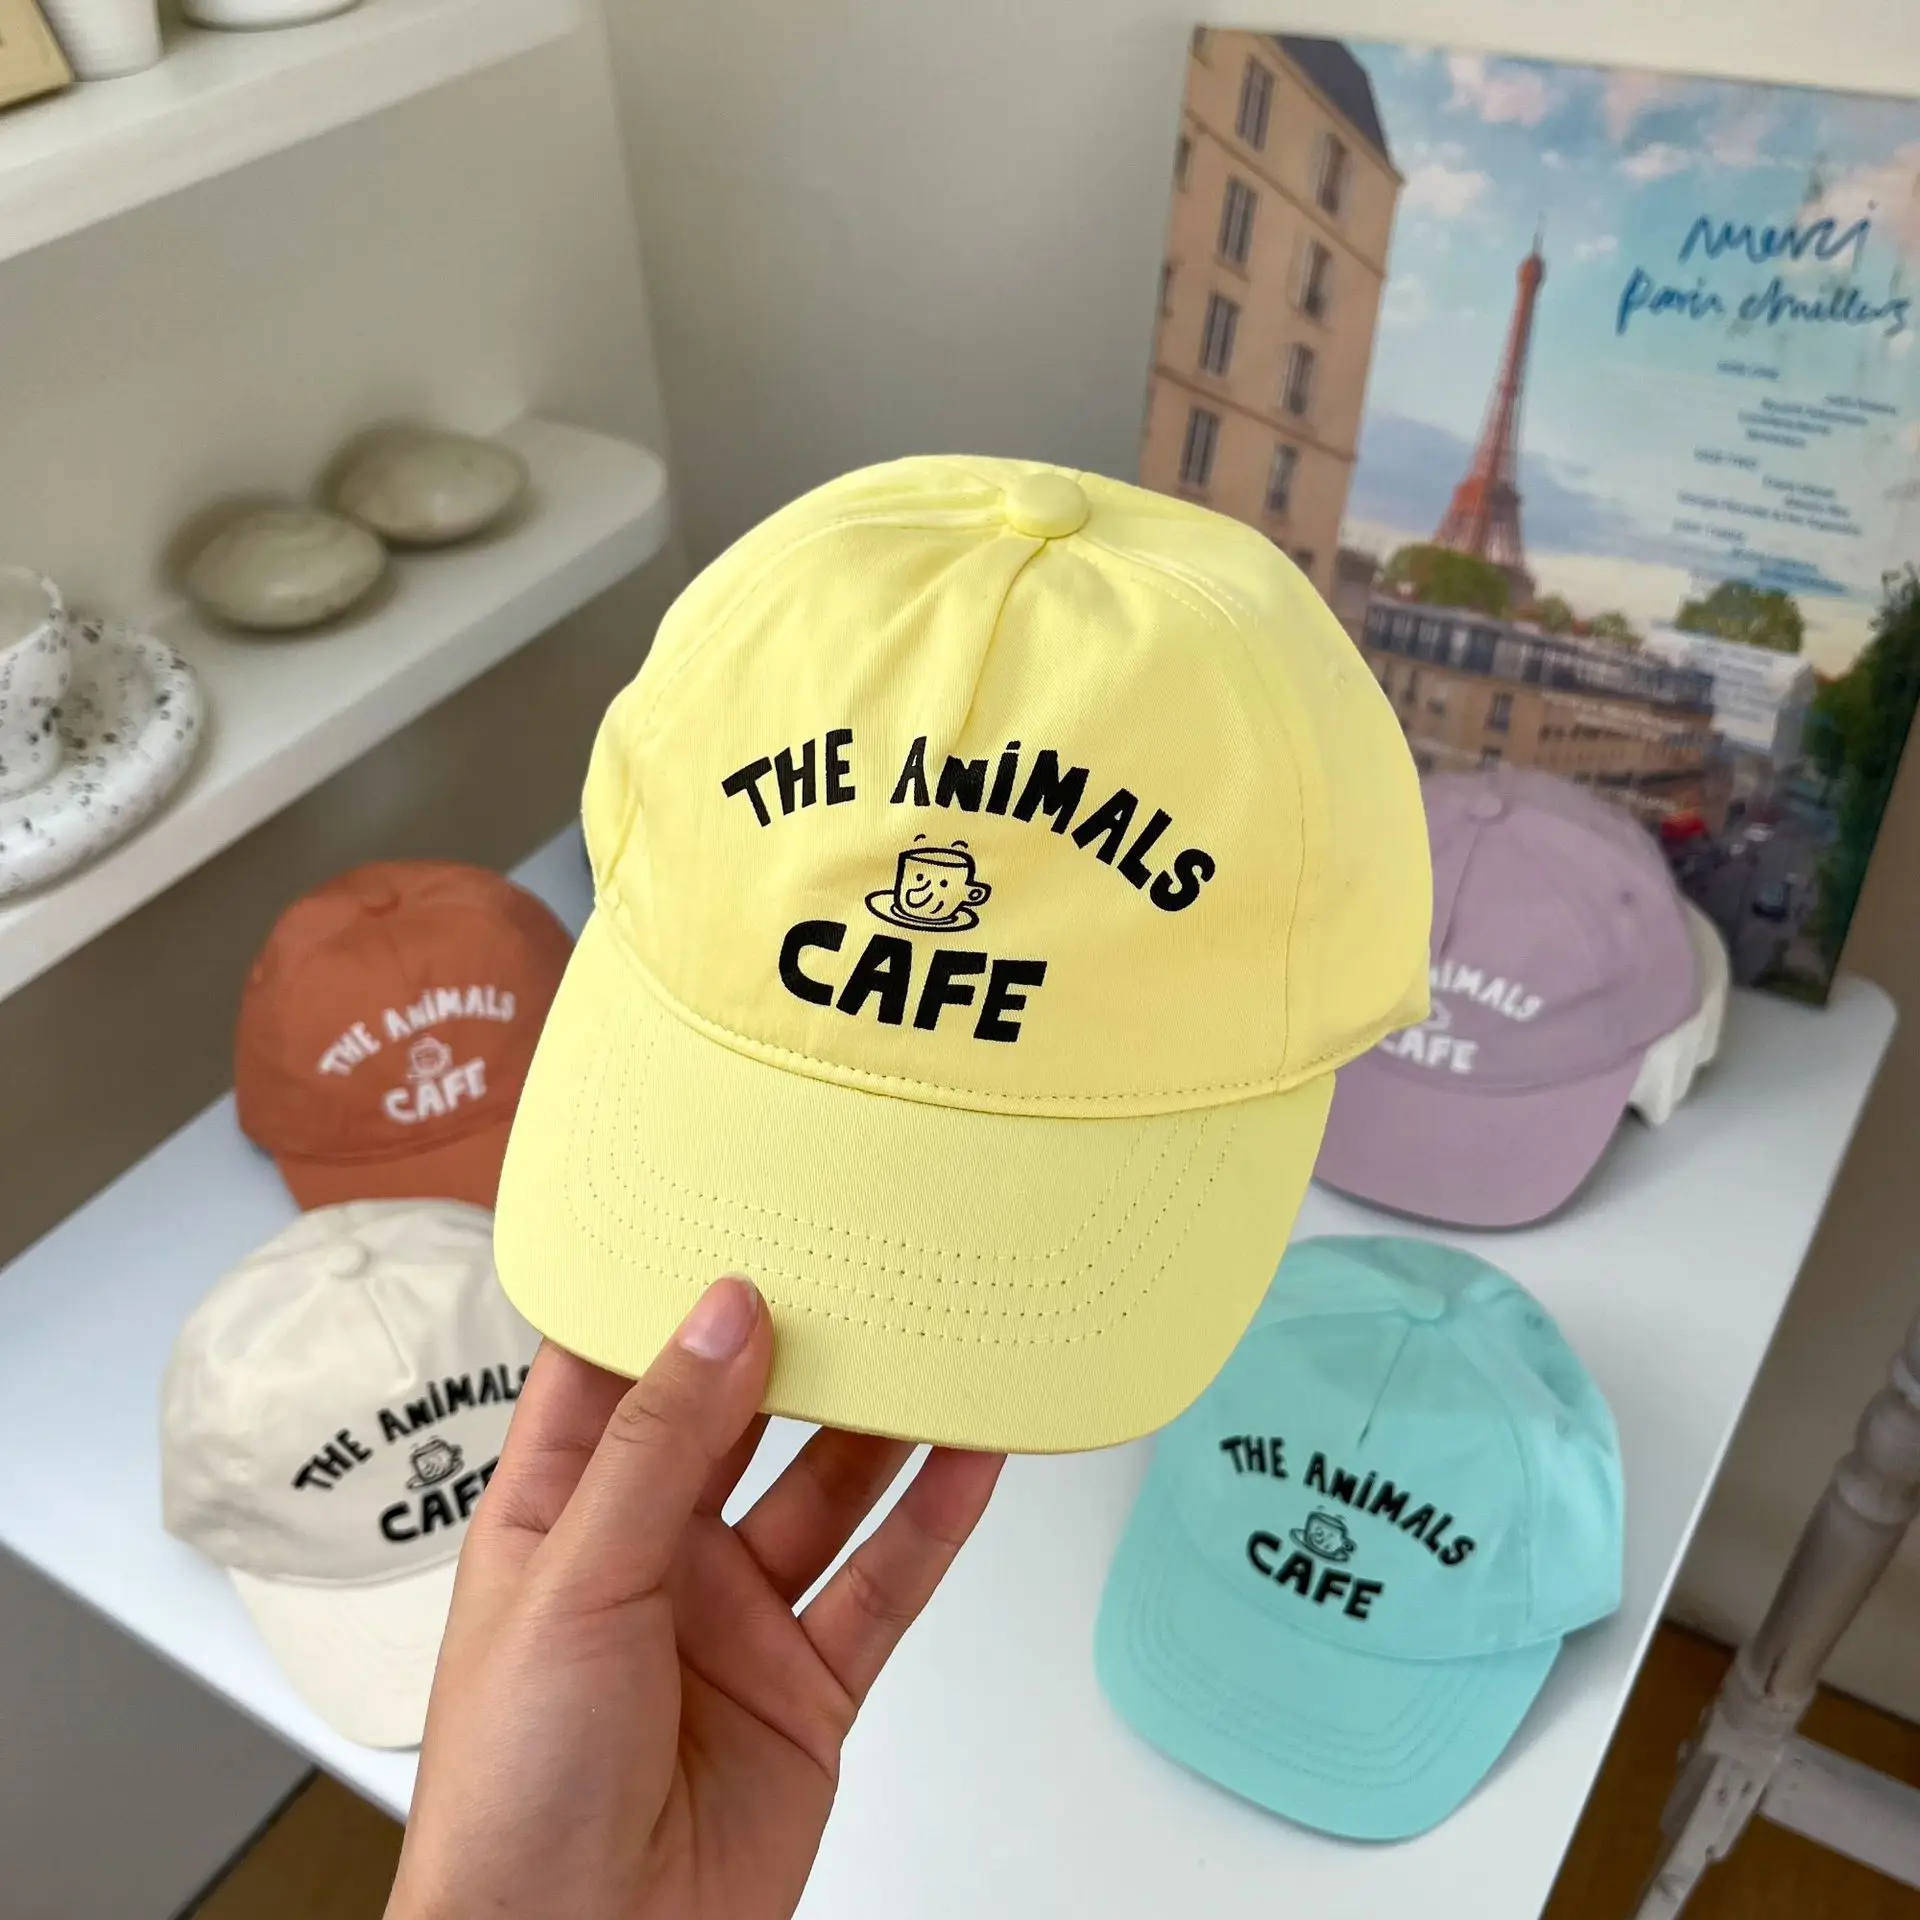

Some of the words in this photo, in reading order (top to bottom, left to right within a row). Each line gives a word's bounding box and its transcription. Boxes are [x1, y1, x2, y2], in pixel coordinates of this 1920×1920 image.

[721, 728, 856, 828] THE
[778, 919, 1048, 1043] CAFE
[317, 1021, 382, 1076] THE
[383, 1057, 487, 1125] CAFE
[291, 1427, 374, 1491] THE
[1219, 1434, 1289, 1480] THE
[1245, 1529, 1385, 1621] CAFE
